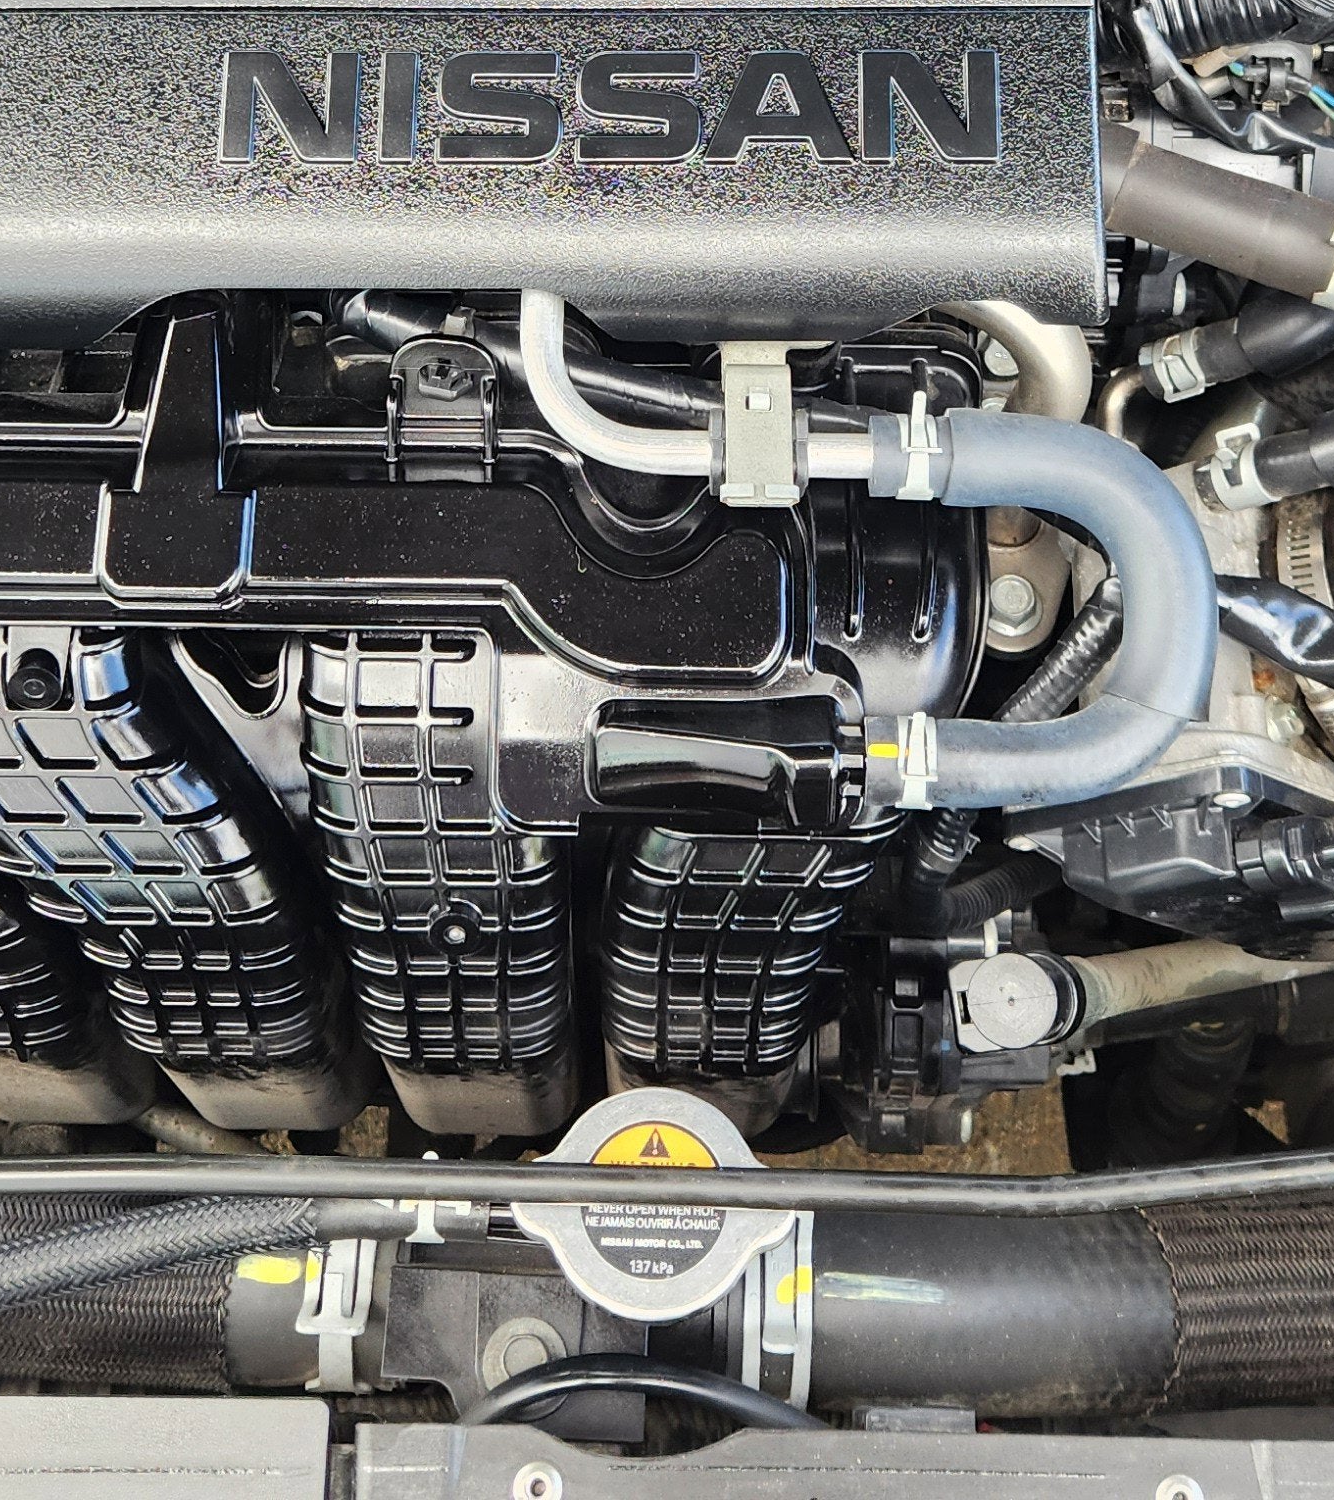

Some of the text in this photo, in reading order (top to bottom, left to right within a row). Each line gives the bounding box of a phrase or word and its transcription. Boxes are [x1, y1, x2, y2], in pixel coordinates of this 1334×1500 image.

[217, 49, 1003, 164] NISSAN
[625, 1205, 657, 1215] OPEN
[658, 1206, 692, 1216] WHEN
[585, 1215, 600, 1227] NE
[601, 1215, 635, 1228] JAMAIS
[635, 1217, 673, 1229] OUVRIR
[600, 1237, 634, 1248] NISSAN
[634, 1237, 667, 1248] MOTOR
[629, 1259, 674, 1275] 137 kPa
